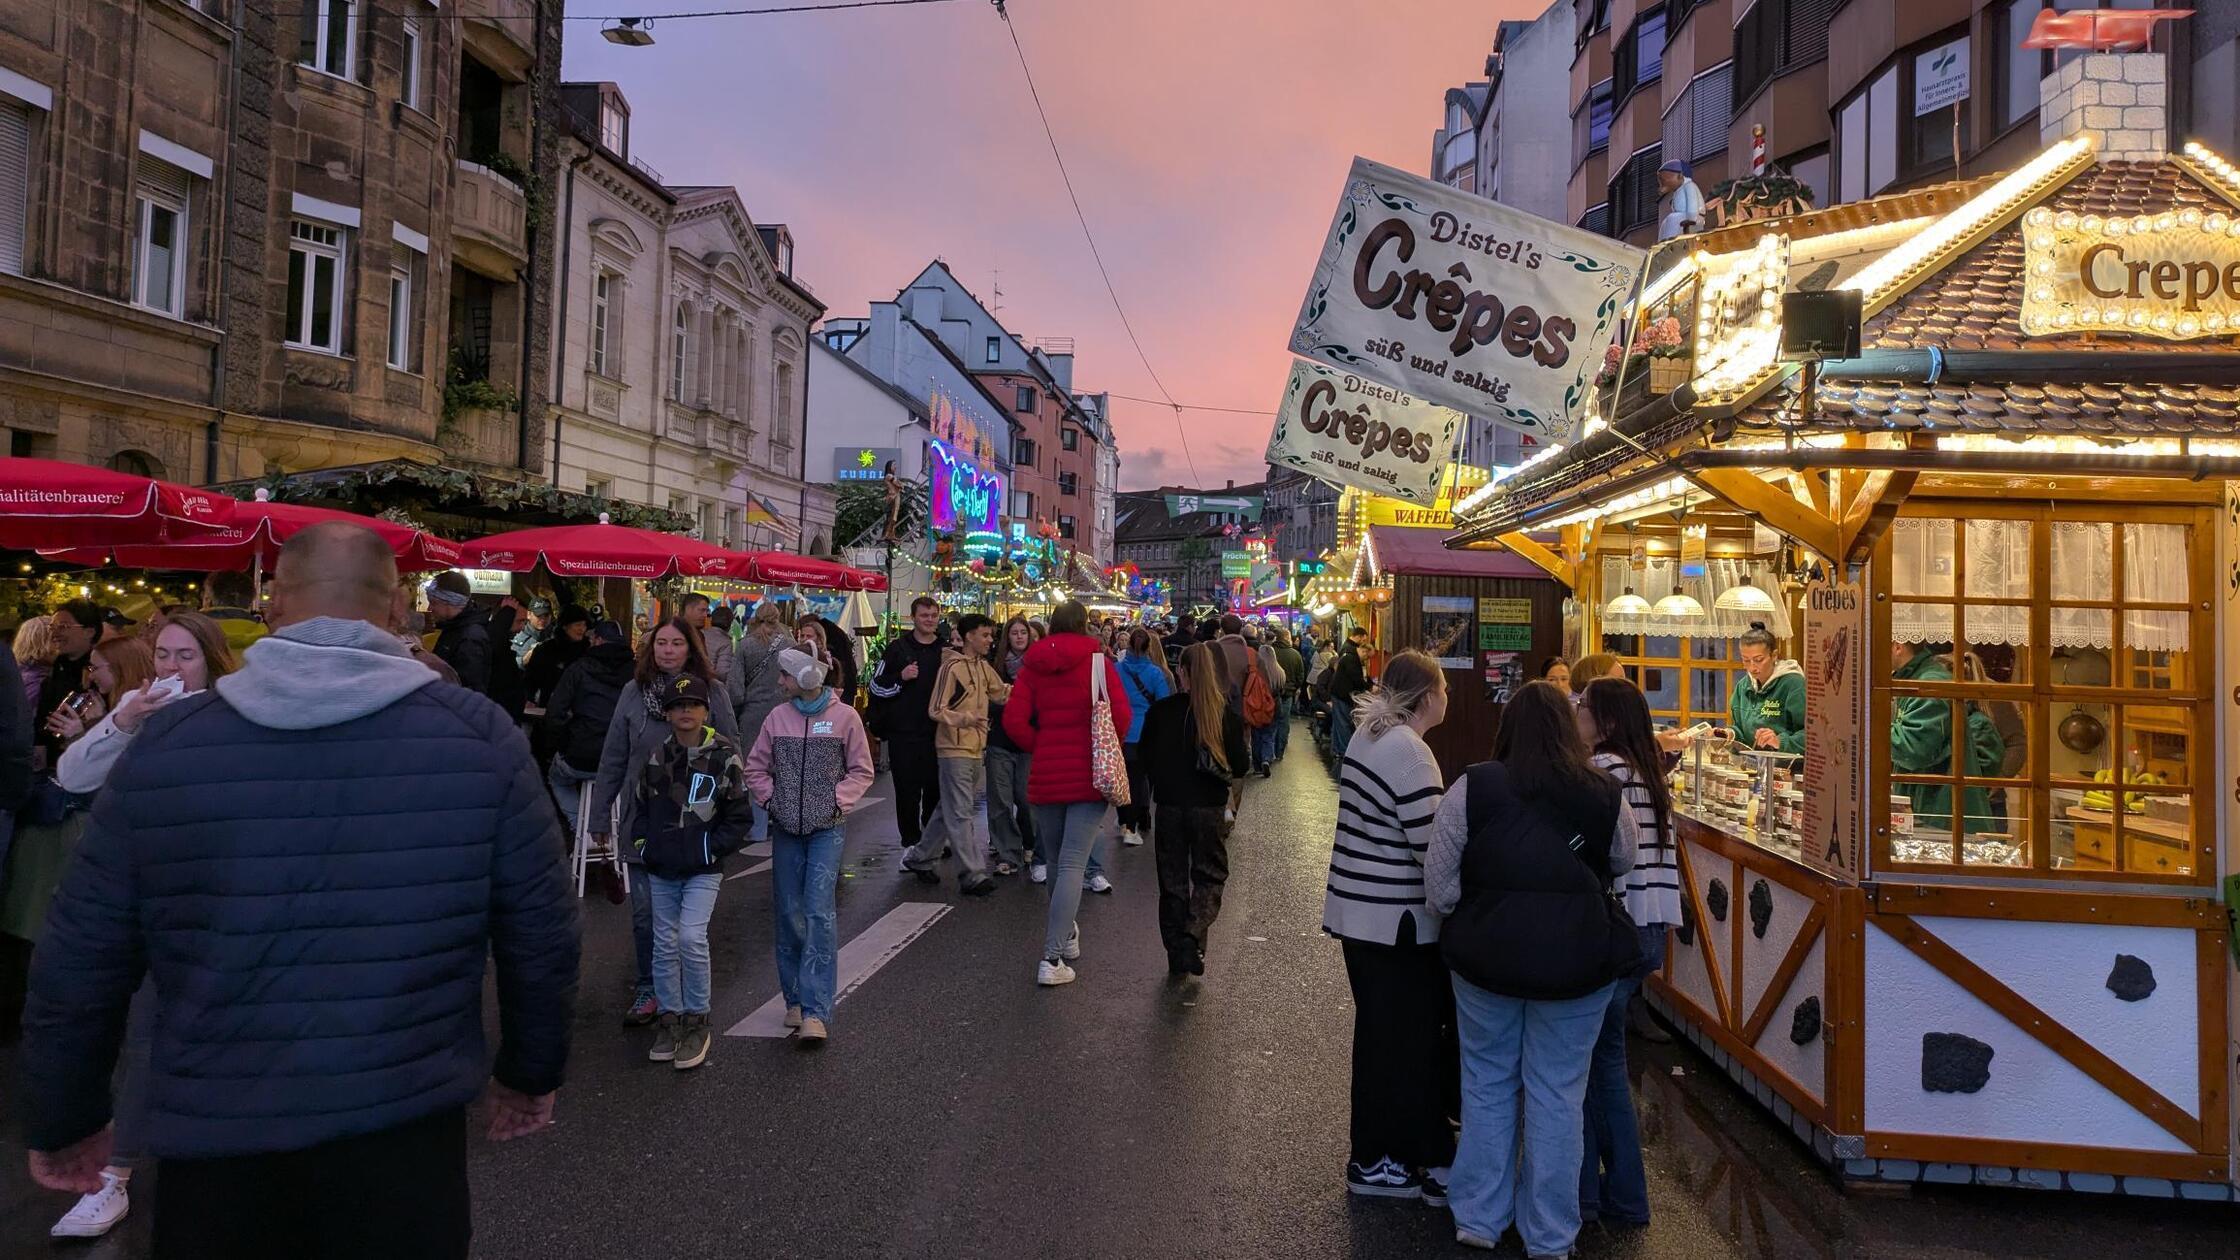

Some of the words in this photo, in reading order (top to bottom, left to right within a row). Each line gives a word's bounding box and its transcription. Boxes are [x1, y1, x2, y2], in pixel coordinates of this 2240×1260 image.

[1430, 211, 1543, 270] Distel's
[1353, 217, 1577, 370] Crêpes
[2080, 243, 2240, 312] Crepe
[1344, 375, 1411, 407] Distel's
[1365, 336, 1406, 362] süß
[1411, 352, 1448, 378] und
[1452, 365, 1512, 403] salzig
[1300, 379, 1433, 464] Crêpes
[840, 470, 885, 479] KUHNL
[1310, 449, 1335, 465] süß
[1337, 459, 1361, 473] und
[1363, 464, 1399, 485] salzig
[559, 559, 655, 573] Spezialitätenbrauerei
[1811, 585, 1857, 614] Crêpes
